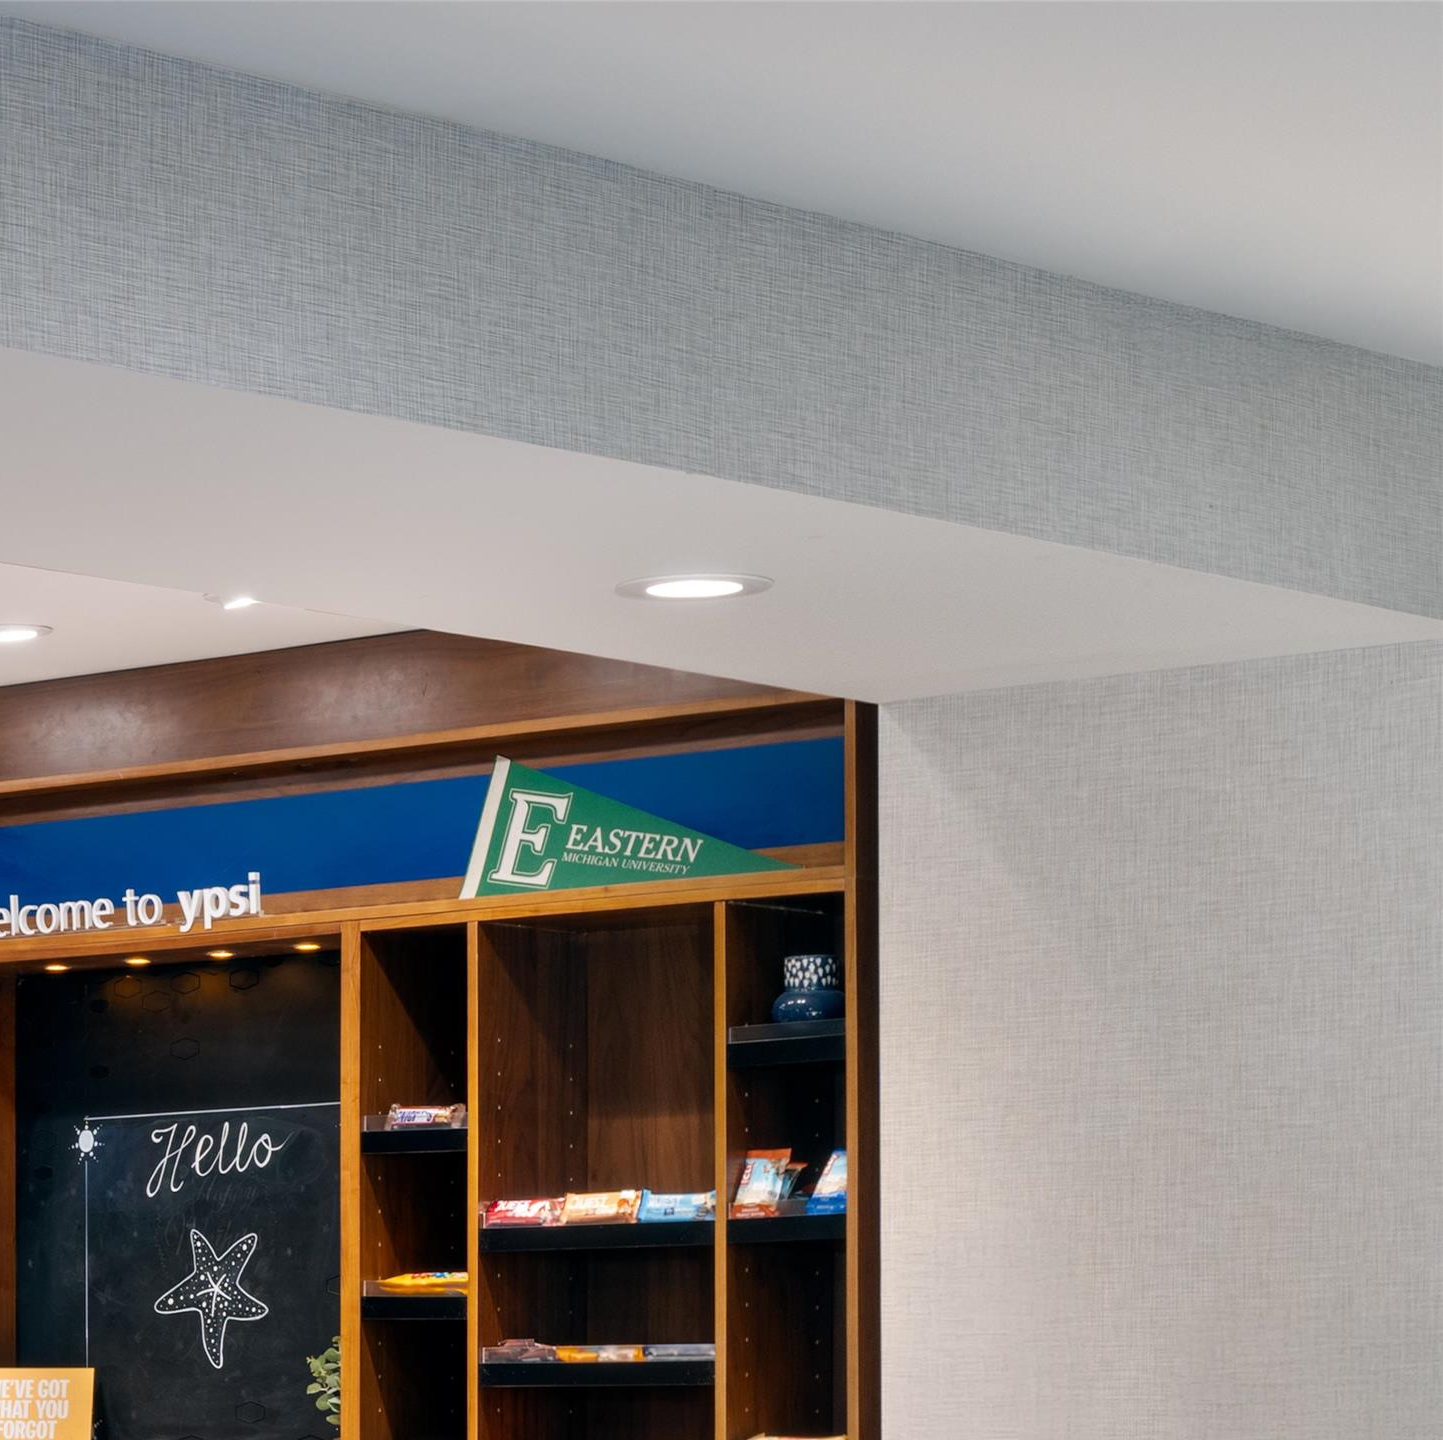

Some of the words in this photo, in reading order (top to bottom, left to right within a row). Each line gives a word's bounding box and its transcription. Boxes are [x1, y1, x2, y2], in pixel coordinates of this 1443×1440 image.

[487, 788, 574, 889] E
[565, 823, 704, 864] EASTERN
[561, 851, 619, 868] MICHIGAN
[621, 857, 691, 875] UNIVERSITY
[121, 888, 163, 926] to
[176, 871, 261, 933] ypsi
[146, 1121, 292, 1198] Hello
[34, 1399, 70, 1419] YOU
[37, 1378, 71, 1399] GOT
